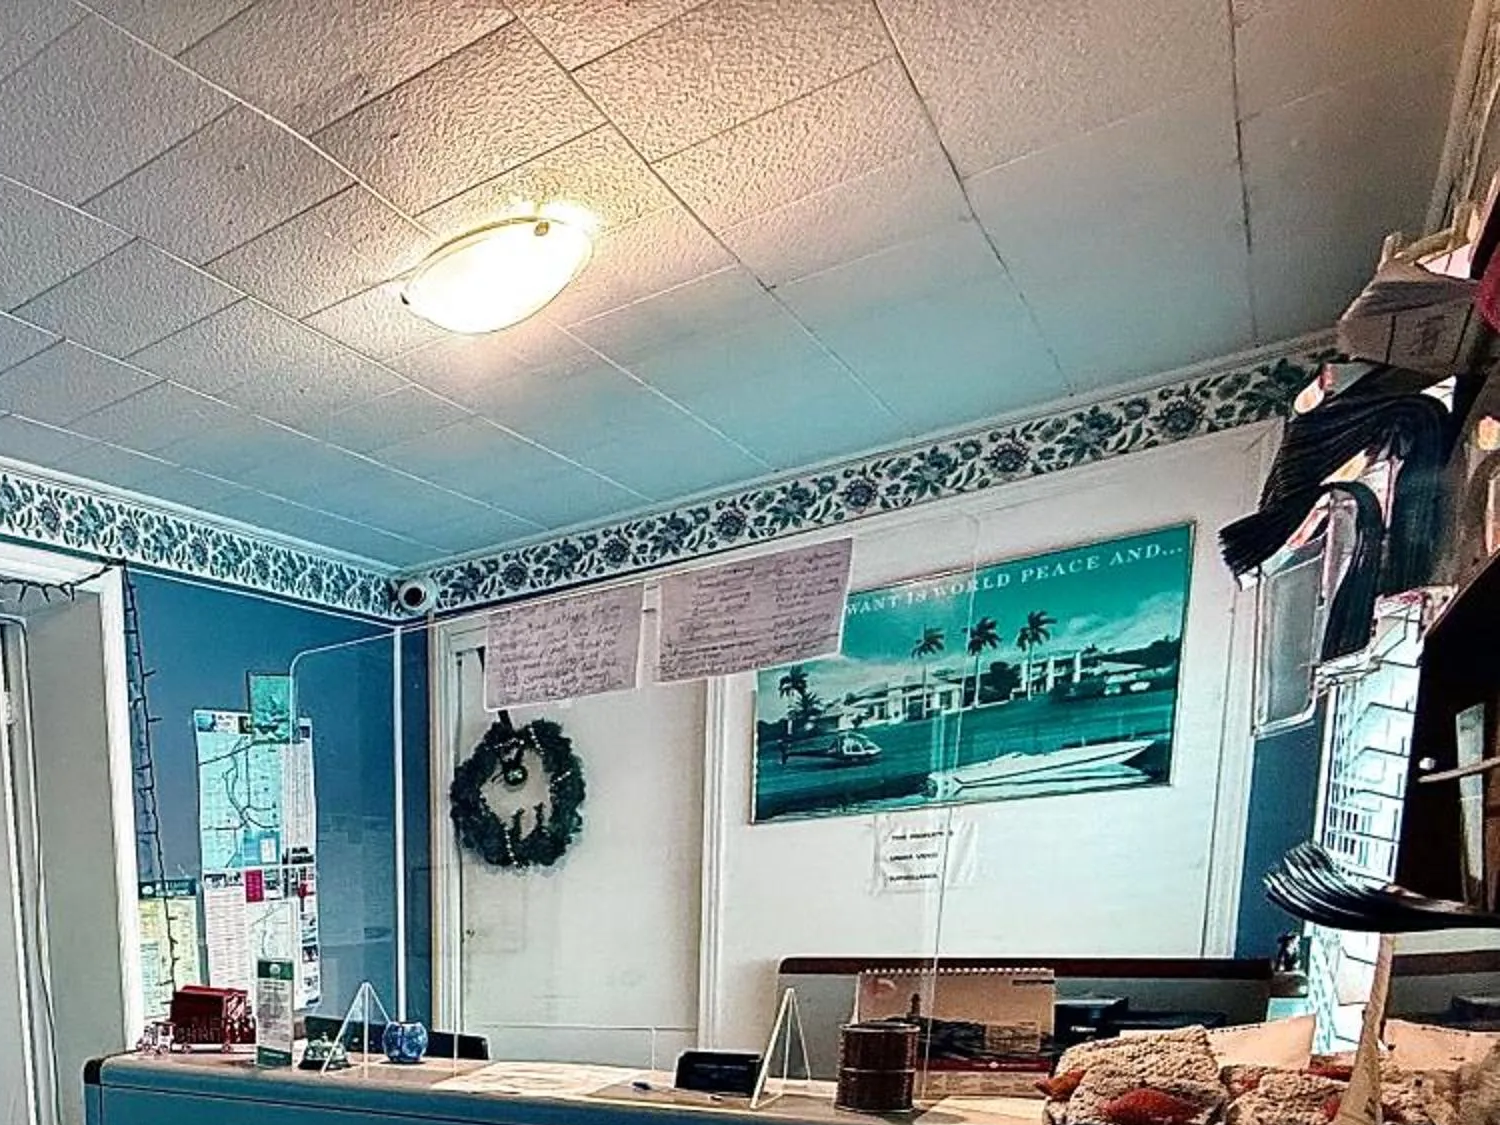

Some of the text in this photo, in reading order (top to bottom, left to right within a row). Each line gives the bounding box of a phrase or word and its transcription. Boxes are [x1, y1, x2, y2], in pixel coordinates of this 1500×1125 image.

[933, 572, 1011, 600] WORLD
[1021, 554, 1101, 583] PEACE
[1109, 542, 1184, 567] AND...
